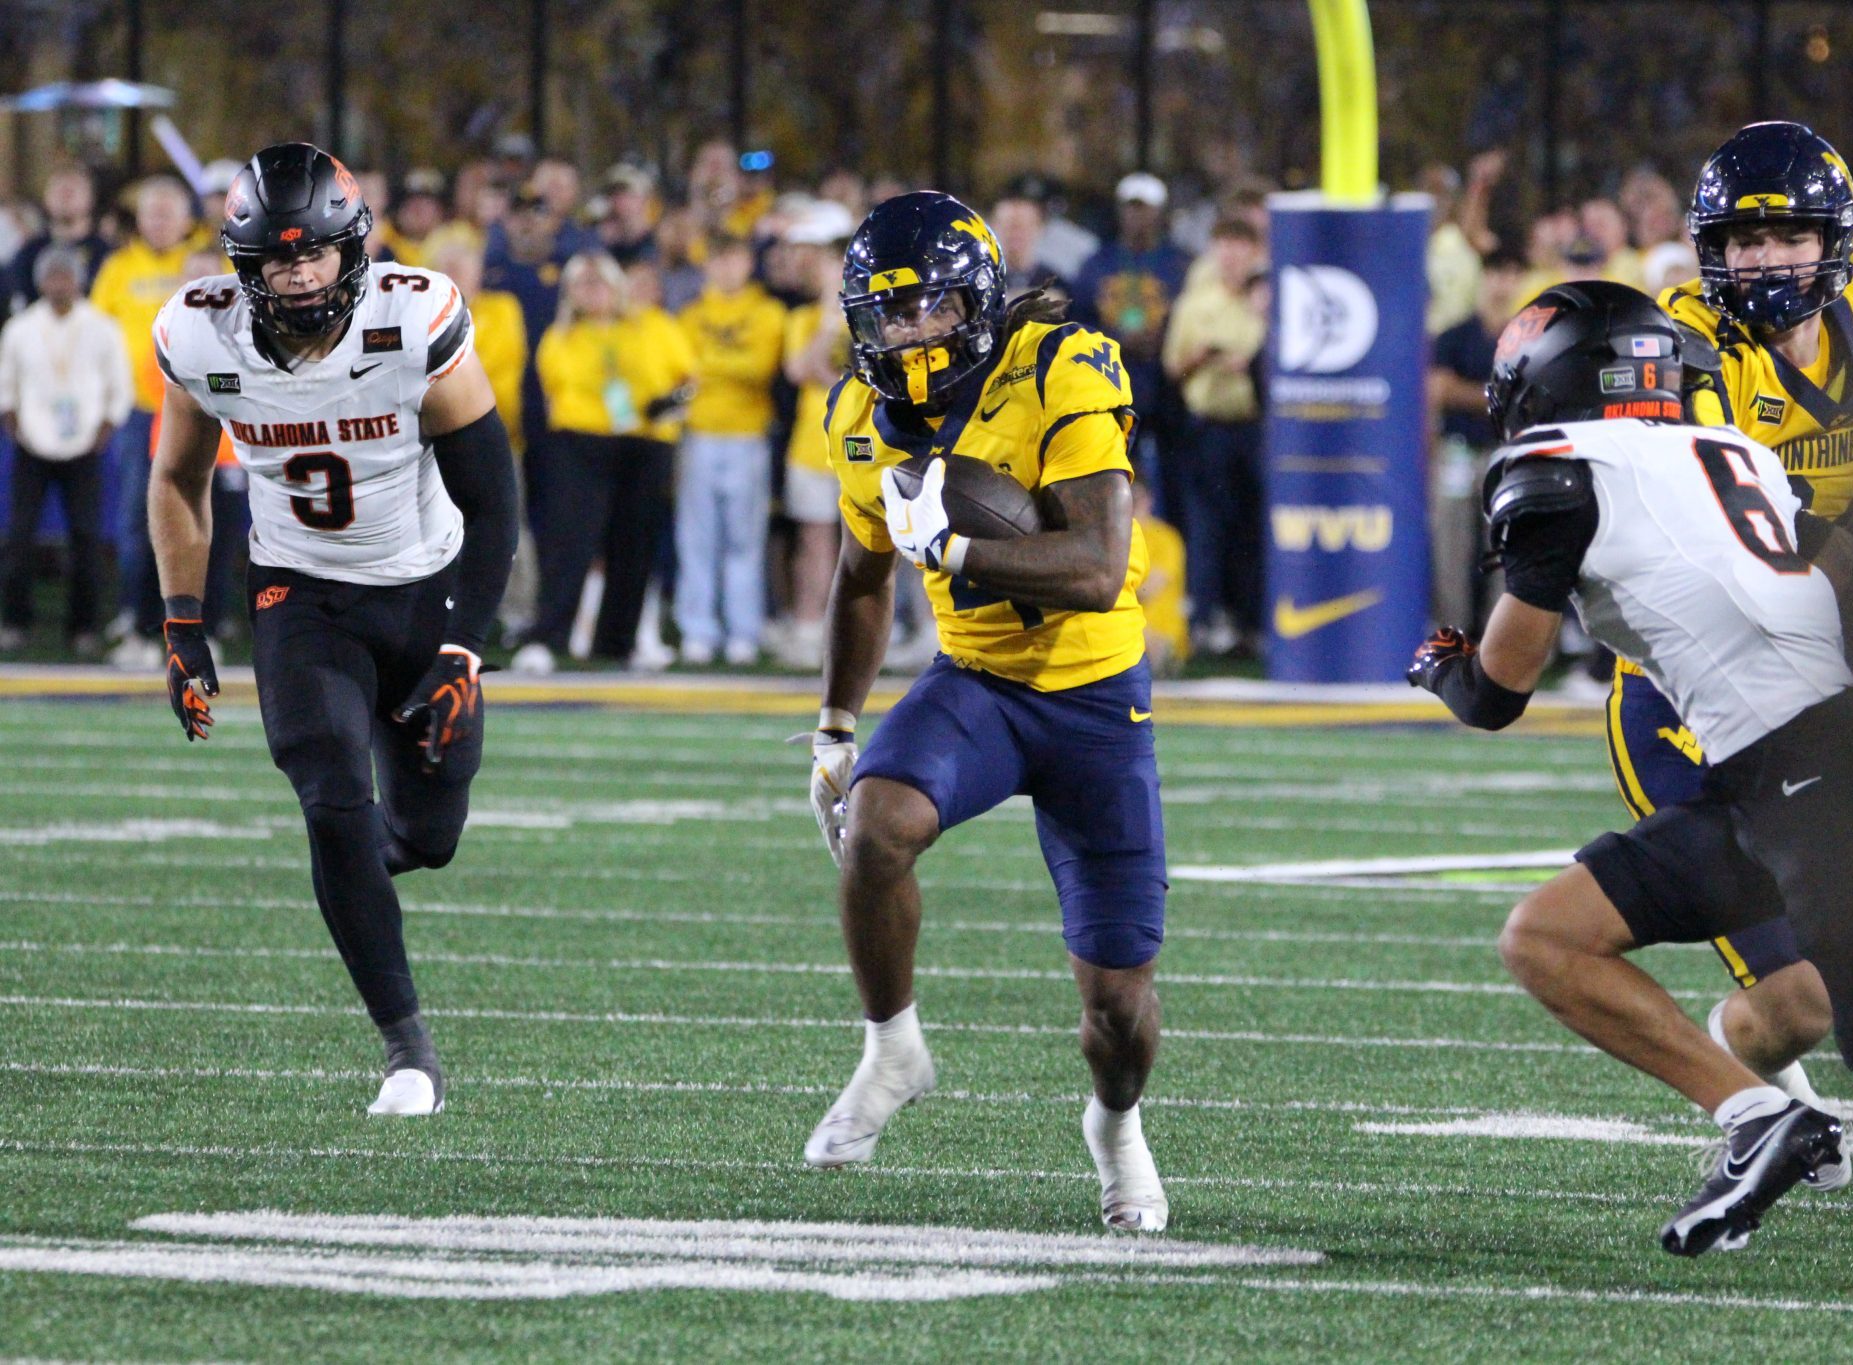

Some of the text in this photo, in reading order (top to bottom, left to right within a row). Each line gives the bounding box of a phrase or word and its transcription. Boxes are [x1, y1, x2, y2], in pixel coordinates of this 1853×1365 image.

[380, 273, 430, 293] 3
[184, 288, 235, 310] 3
[1643, 362, 1657, 390] 6
[1603, 401, 1661, 419] OKLAHOMA
[230, 413, 399, 447] OKLAHOMA STATE
[282, 451, 355, 531] 3
[1692, 435, 1813, 576] 6
[1270, 504, 1394, 552] WVU
